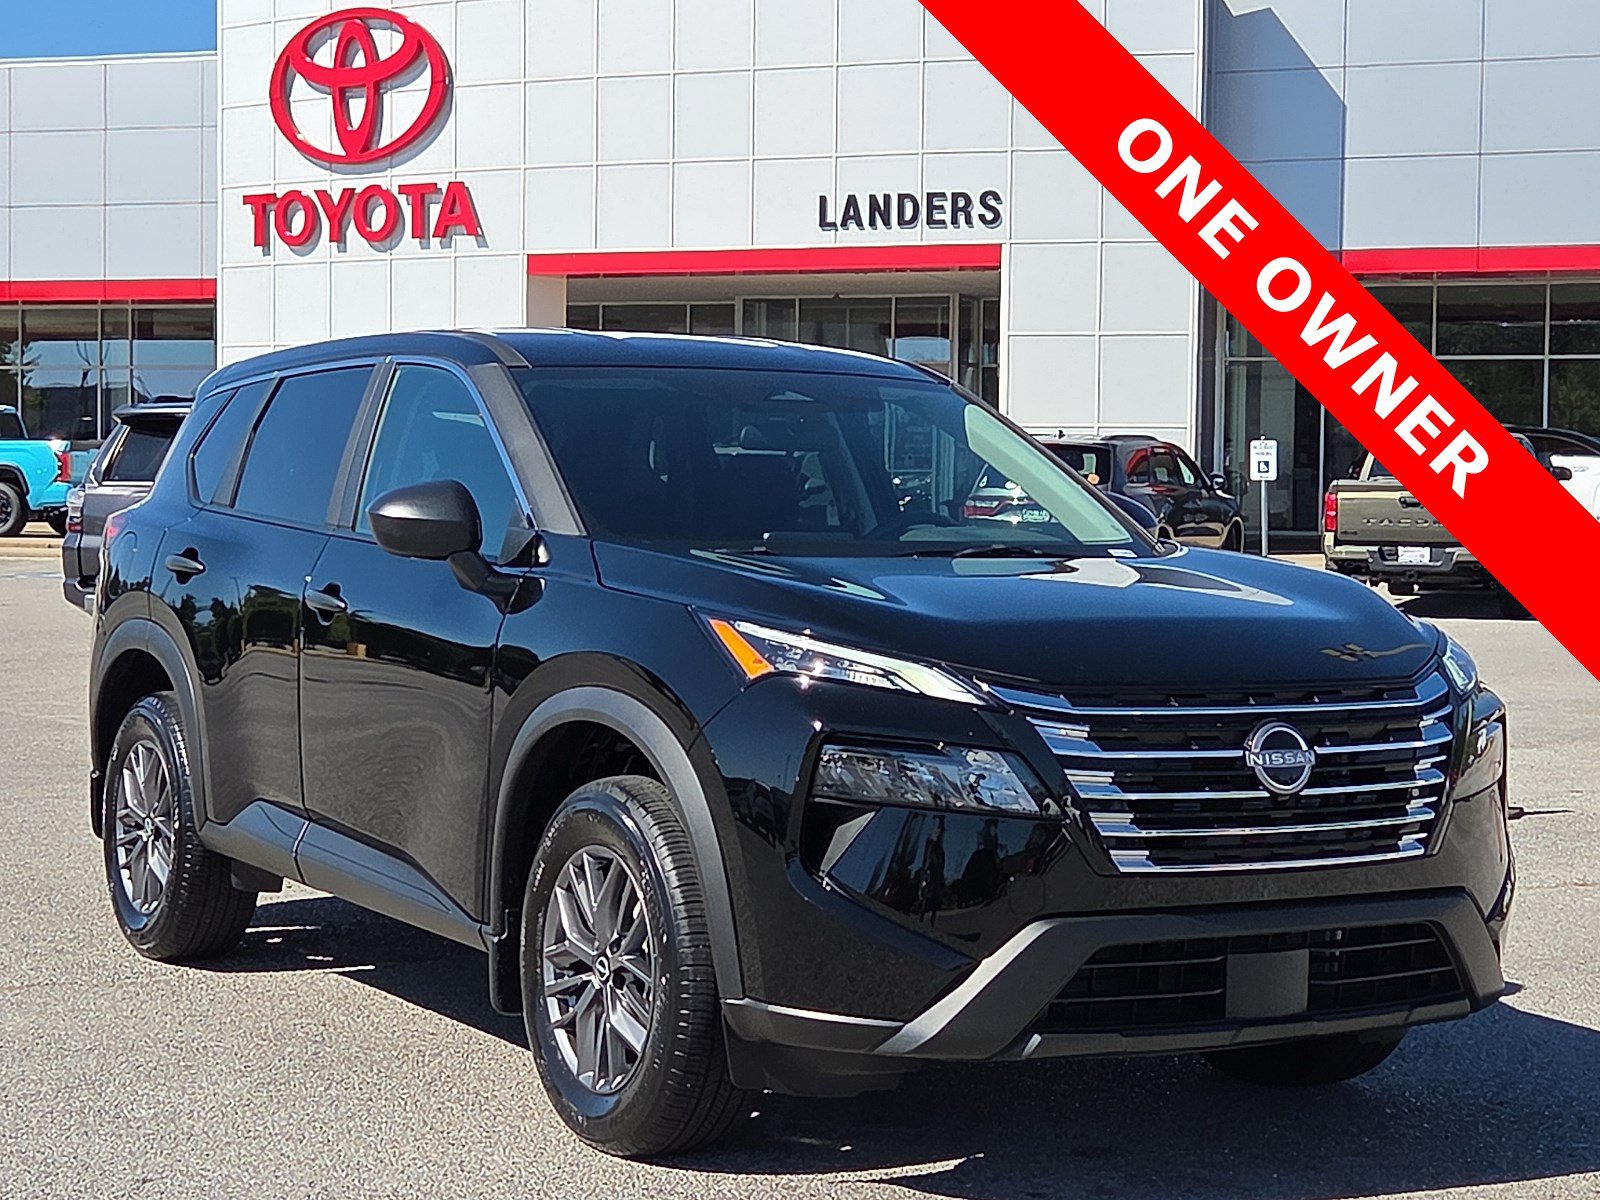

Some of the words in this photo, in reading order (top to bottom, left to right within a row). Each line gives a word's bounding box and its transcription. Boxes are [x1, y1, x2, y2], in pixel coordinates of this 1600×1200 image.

[243, 181, 482, 248] TOYOTA
[819, 190, 1003, 231] LANDERS
[1249, 752, 1315, 765] NISSAN
